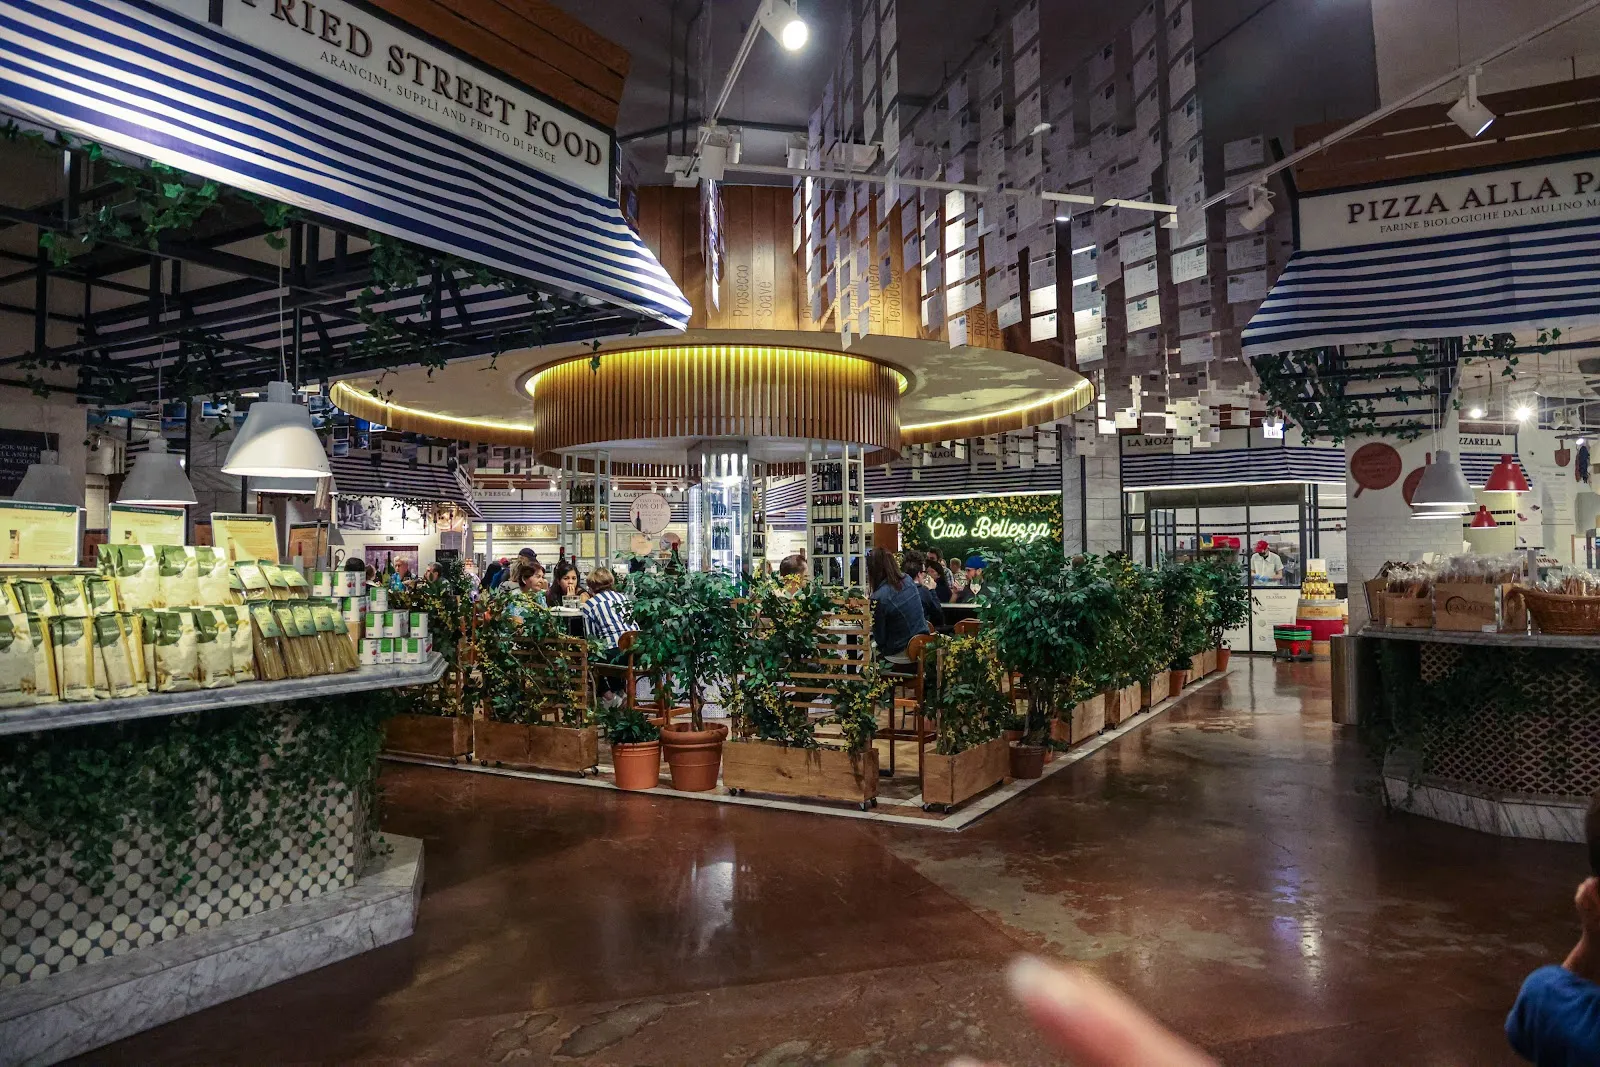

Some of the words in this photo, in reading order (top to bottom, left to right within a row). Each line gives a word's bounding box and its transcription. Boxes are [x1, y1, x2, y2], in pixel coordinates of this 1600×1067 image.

[241, 0, 372, 58] RIED
[387, 44, 516, 126] STREET
[523, 108, 602, 166] FOOD
[319, 50, 392, 92] ARANCINI,
[442, 106, 466, 123] AND
[470, 117, 510, 143] FRITTO
[513, 137, 524, 150] DI
[527, 143, 557, 164] PESCE
[1347, 194, 1450, 225] PIZZA
[1459, 176, 1561, 210] ALLA
[1380, 221, 1420, 234] FARINE
[1423, 211, 1500, 229] BIOLOGICHE
[1503, 207, 1527, 218] DAL
[1530, 199, 1583, 215] MULINO
[732, 264, 749, 317] Prosecco
[756, 281, 773, 317] Soave
[1459, 437, 1502, 446] ZZARELLA
[927, 516, 967, 540] Ciao
[970, 515, 1051, 544] Bellezza
